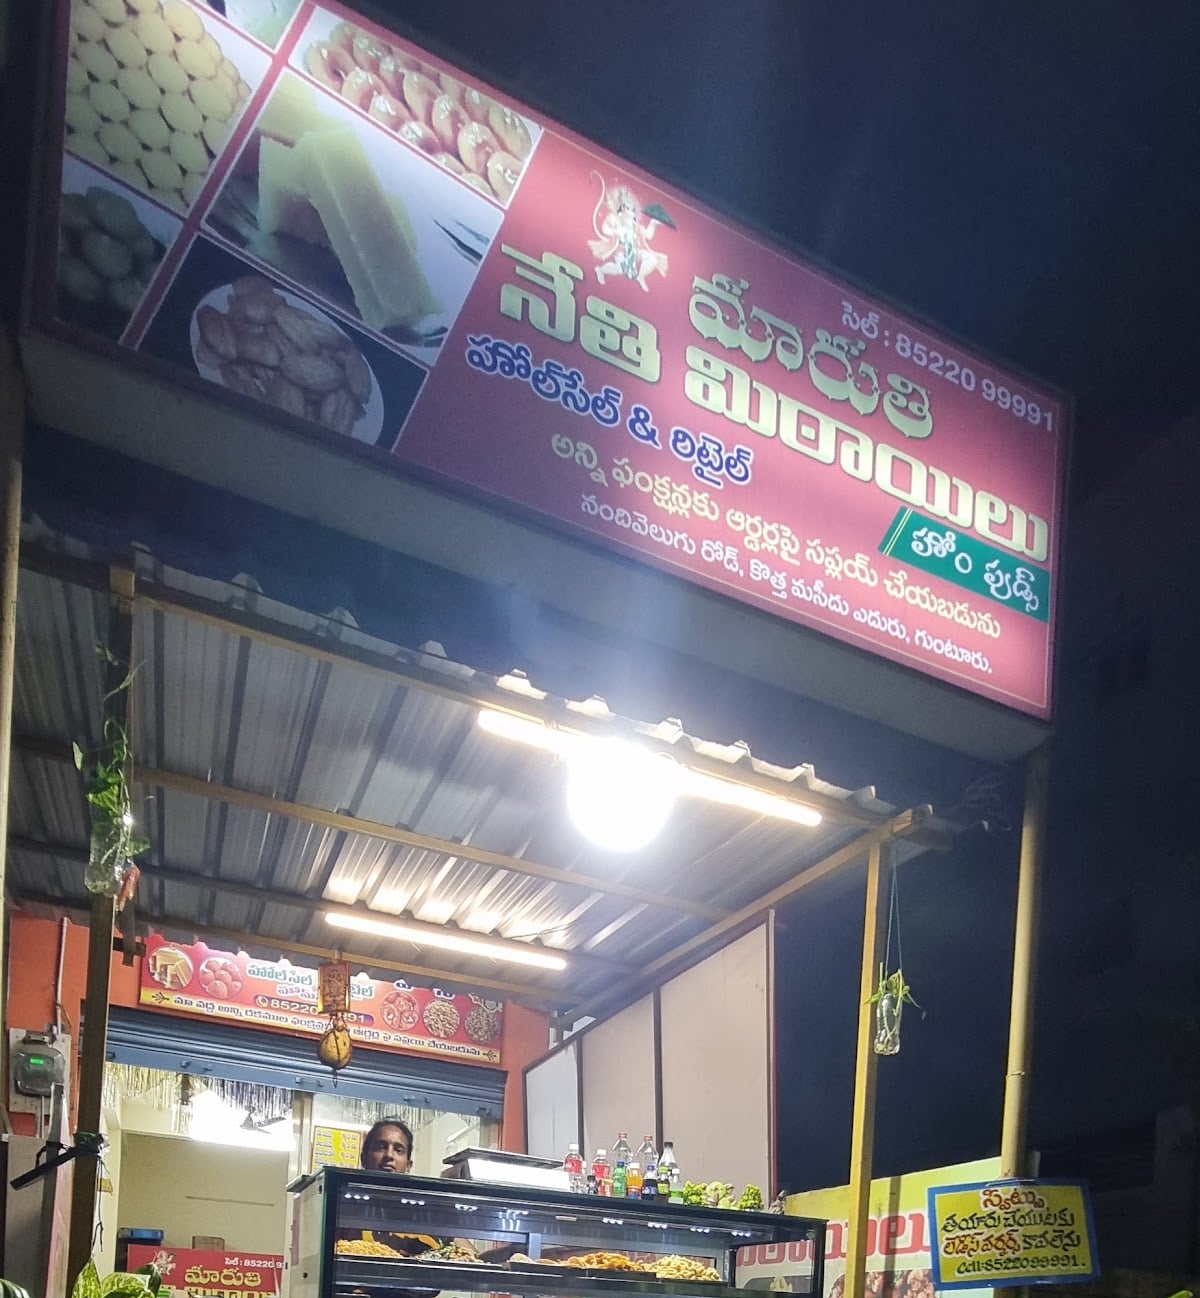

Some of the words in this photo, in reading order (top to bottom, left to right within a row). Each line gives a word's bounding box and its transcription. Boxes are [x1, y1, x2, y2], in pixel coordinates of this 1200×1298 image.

[688, 272, 935, 438] మారుతి
[841, 300, 880, 339] సెల్
[895, 333, 976, 391] 85220
[981, 378, 1053, 432] 99991
[499, 242, 662, 383] నేతి
[684, 344, 1049, 562] మిఠాయిలు
[627, 403, 662, 450] &
[670, 425, 754, 489] రిటైల్
[551, 432, 609, 487] అన్ని
[611, 456, 720, 522] ఫంక్షన్లకు
[725, 507, 801, 566] ఆర్డర్లపై
[804, 538, 879, 588] సప్లయ్
[882, 569, 1001, 639] చేయబడును
[580, 493, 697, 555] నందివెలుగు
[701, 540, 745, 577] రోడ్,
[749, 557, 788, 600] కొత్త
[790, 577, 849, 616] మసీదు
[852, 606, 911, 644] ఎదురు,
[913, 628, 993, 674] గుంటూరు.
[270, 1000, 318, 1015] 85220
[243, 1258, 274, 1269] 85220
[942, 1211, 1001, 1233] తయారు
[1022, 1229, 1082, 1251] కావలెను
[184, 1264, 262, 1287] మారుతి
